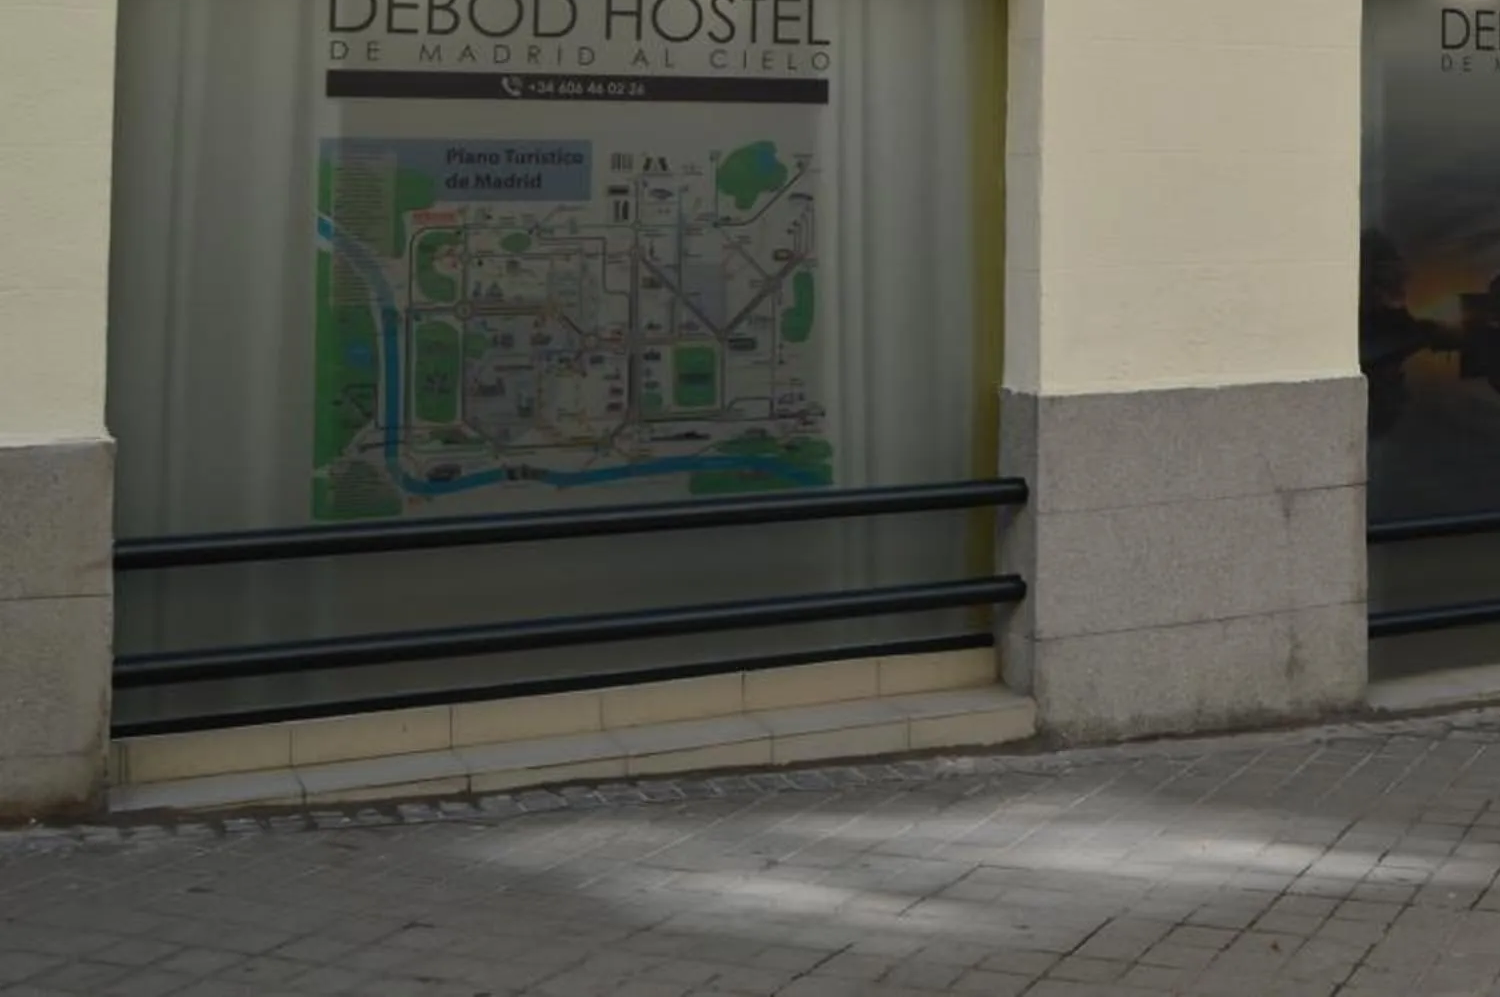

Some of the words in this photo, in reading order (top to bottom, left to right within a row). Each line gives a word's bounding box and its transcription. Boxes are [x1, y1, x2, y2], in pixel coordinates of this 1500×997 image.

[329, 39, 381, 61] DE
[418, 43, 596, 67] MADRID
[631, 47, 676, 69] AL
[709, 49, 831, 72] CIELO
[1441, 56, 1472, 73] DE
[446, 147, 500, 166] Plano
[444, 173, 470, 190] de
[473, 172, 543, 190] Madrid
